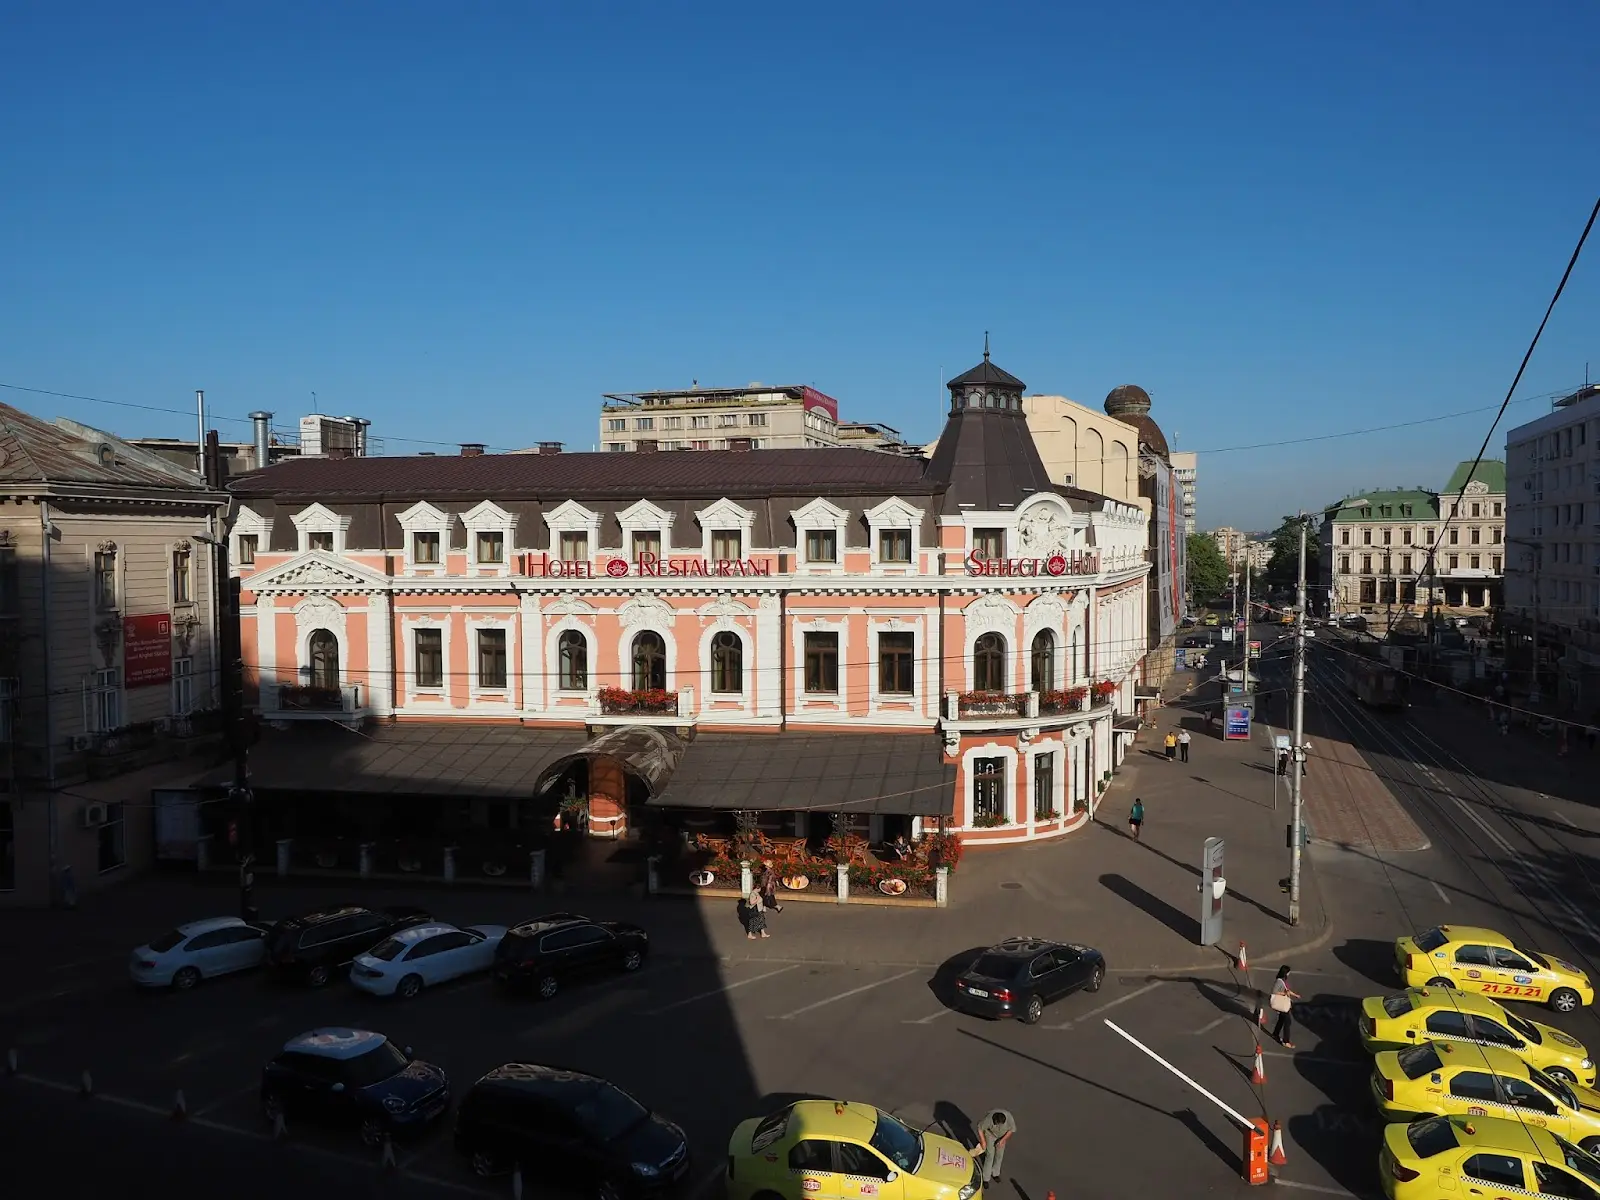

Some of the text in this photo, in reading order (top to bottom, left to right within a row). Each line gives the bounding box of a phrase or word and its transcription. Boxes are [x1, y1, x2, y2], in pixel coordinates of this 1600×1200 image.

[528, 551, 773, 578] HOTEL RESTAURANT
[969, 548, 1040, 576] SELECT
[1481, 983, 1542, 997] 21.21.21
